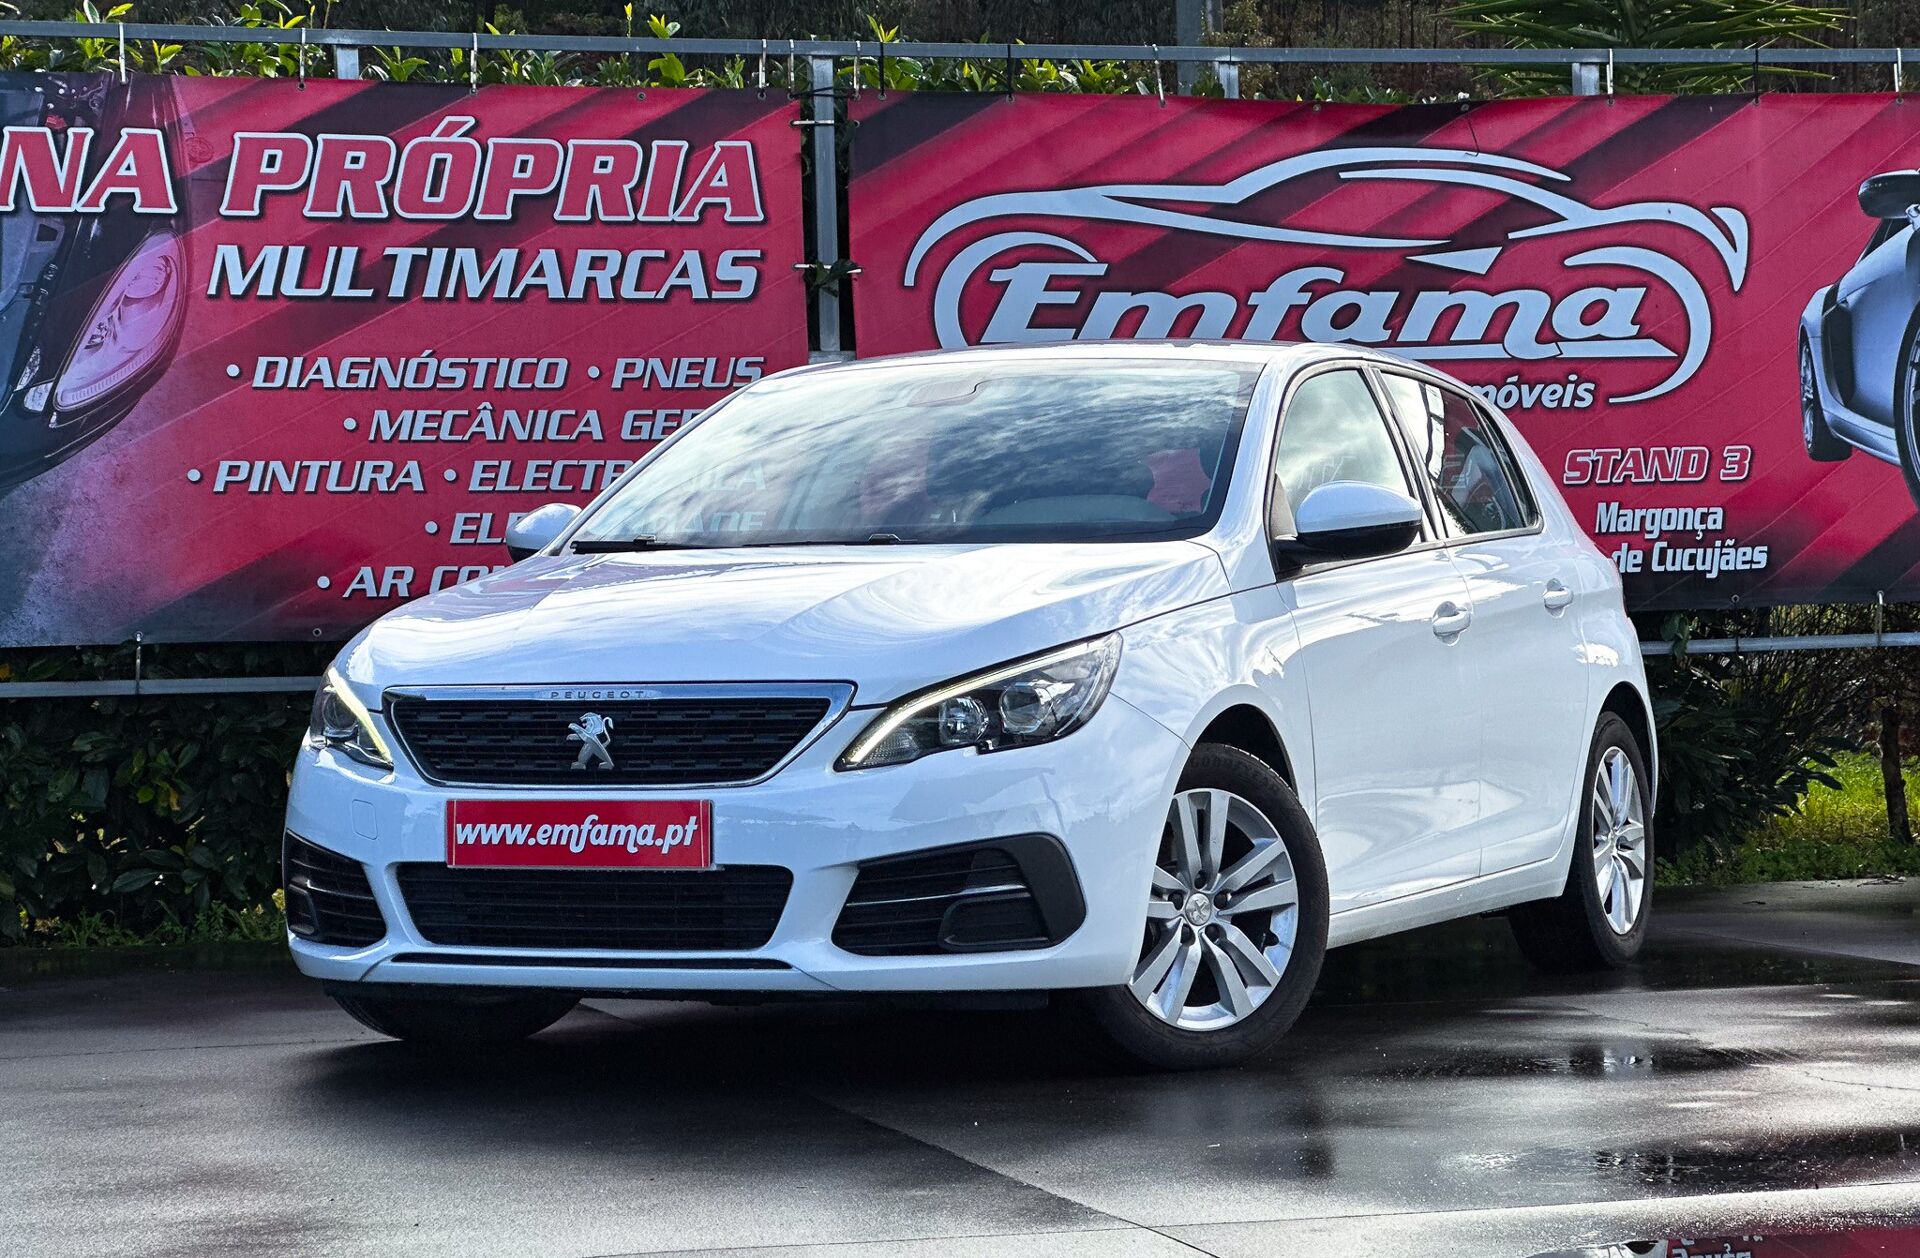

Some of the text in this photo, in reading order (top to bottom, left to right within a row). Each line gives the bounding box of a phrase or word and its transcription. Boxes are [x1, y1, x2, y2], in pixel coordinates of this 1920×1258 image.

[0, 116, 765, 222] NA PRÓPRIA
[207, 244, 762, 300] MULTIMARCAS
[979, 262, 1646, 359] Emfama
[252, 349, 765, 390] DIAGNÓSTICO PNEUS
[367, 402, 604, 442] MECÂNICA
[212, 459, 425, 493] PINTURA
[1563, 445, 1752, 485] STAND 3
[1594, 502, 1723, 540] Margonça
[1611, 539, 1769, 579] de Cucujães
[342, 566, 413, 598] AR
[550, 691, 645, 699] PEUGEOT
[456, 815, 697, 853] www.emfama.pt
